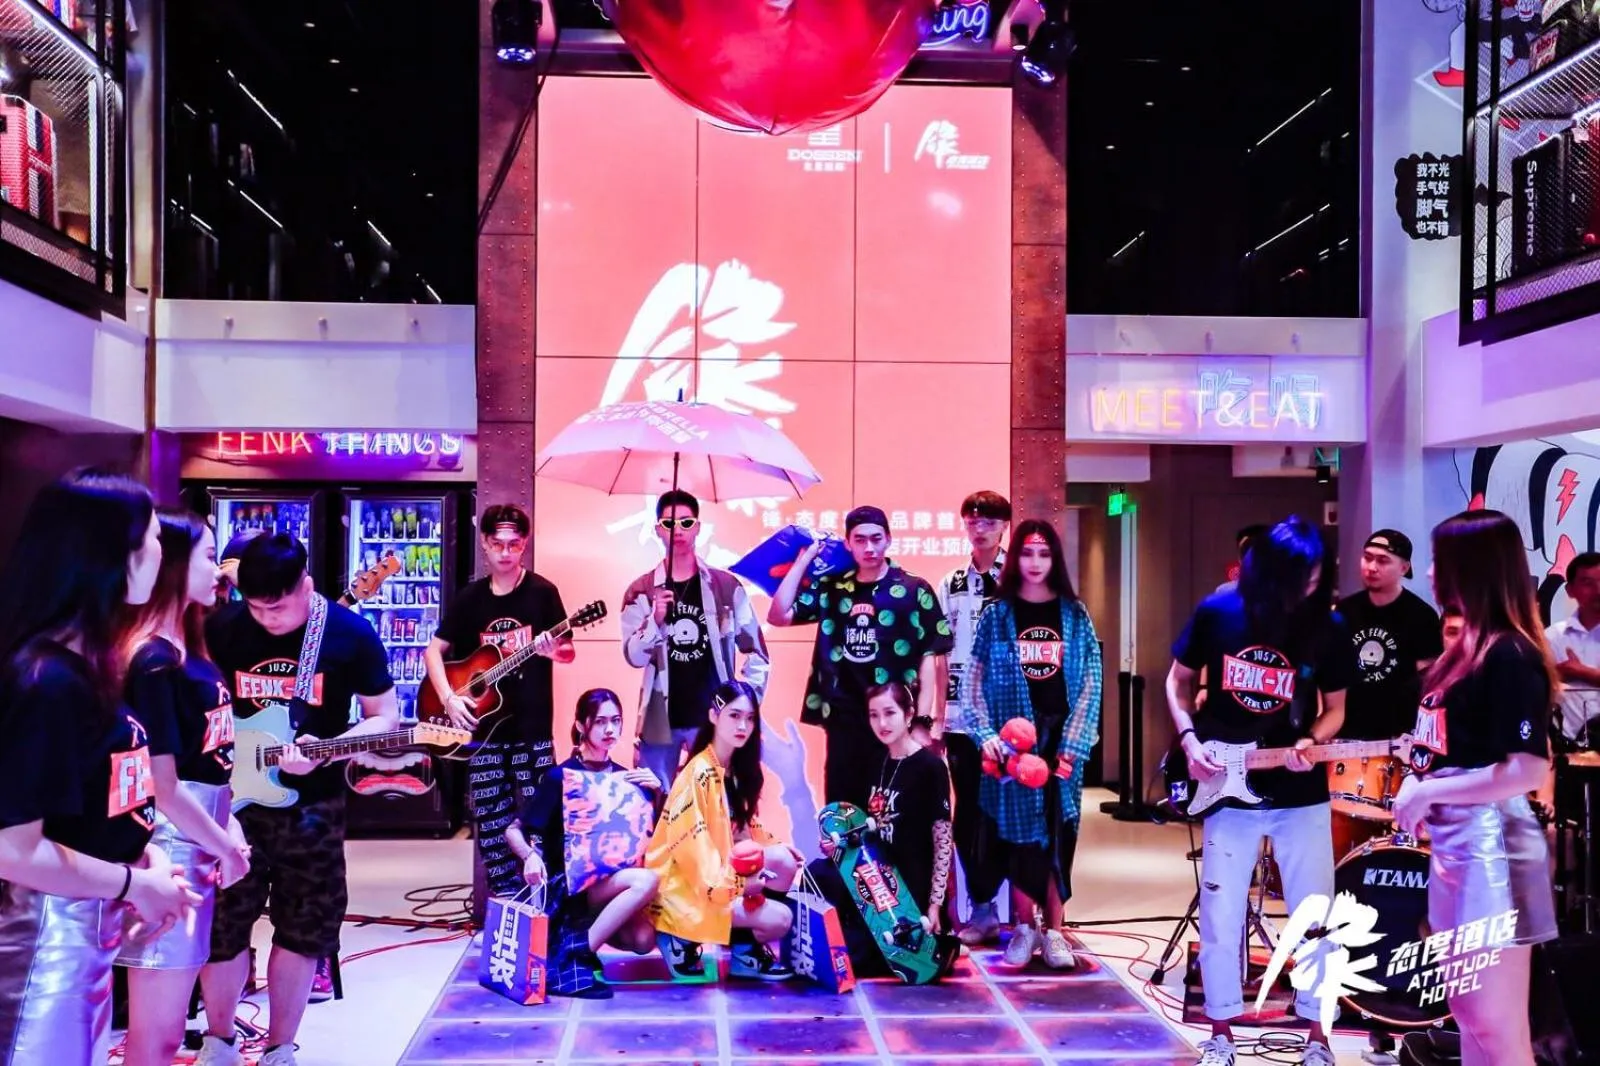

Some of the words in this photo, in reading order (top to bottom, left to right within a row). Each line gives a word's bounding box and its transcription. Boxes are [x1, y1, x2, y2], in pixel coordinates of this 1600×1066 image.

[1416, 163, 1450, 178] 我不光
[1416, 181, 1450, 195] 手气好
[1415, 199, 1449, 219] 脚气
[1524, 160, 1538, 257] Supreme
[1415, 221, 1449, 236] 也不错
[1030, 630, 1050, 640] JUST
[1368, 628, 1388, 640] FENK
[1253, 650, 1277, 664] JUST
[268, 663, 295, 673] JUST
[1226, 659, 1294, 699] FENK-XL
